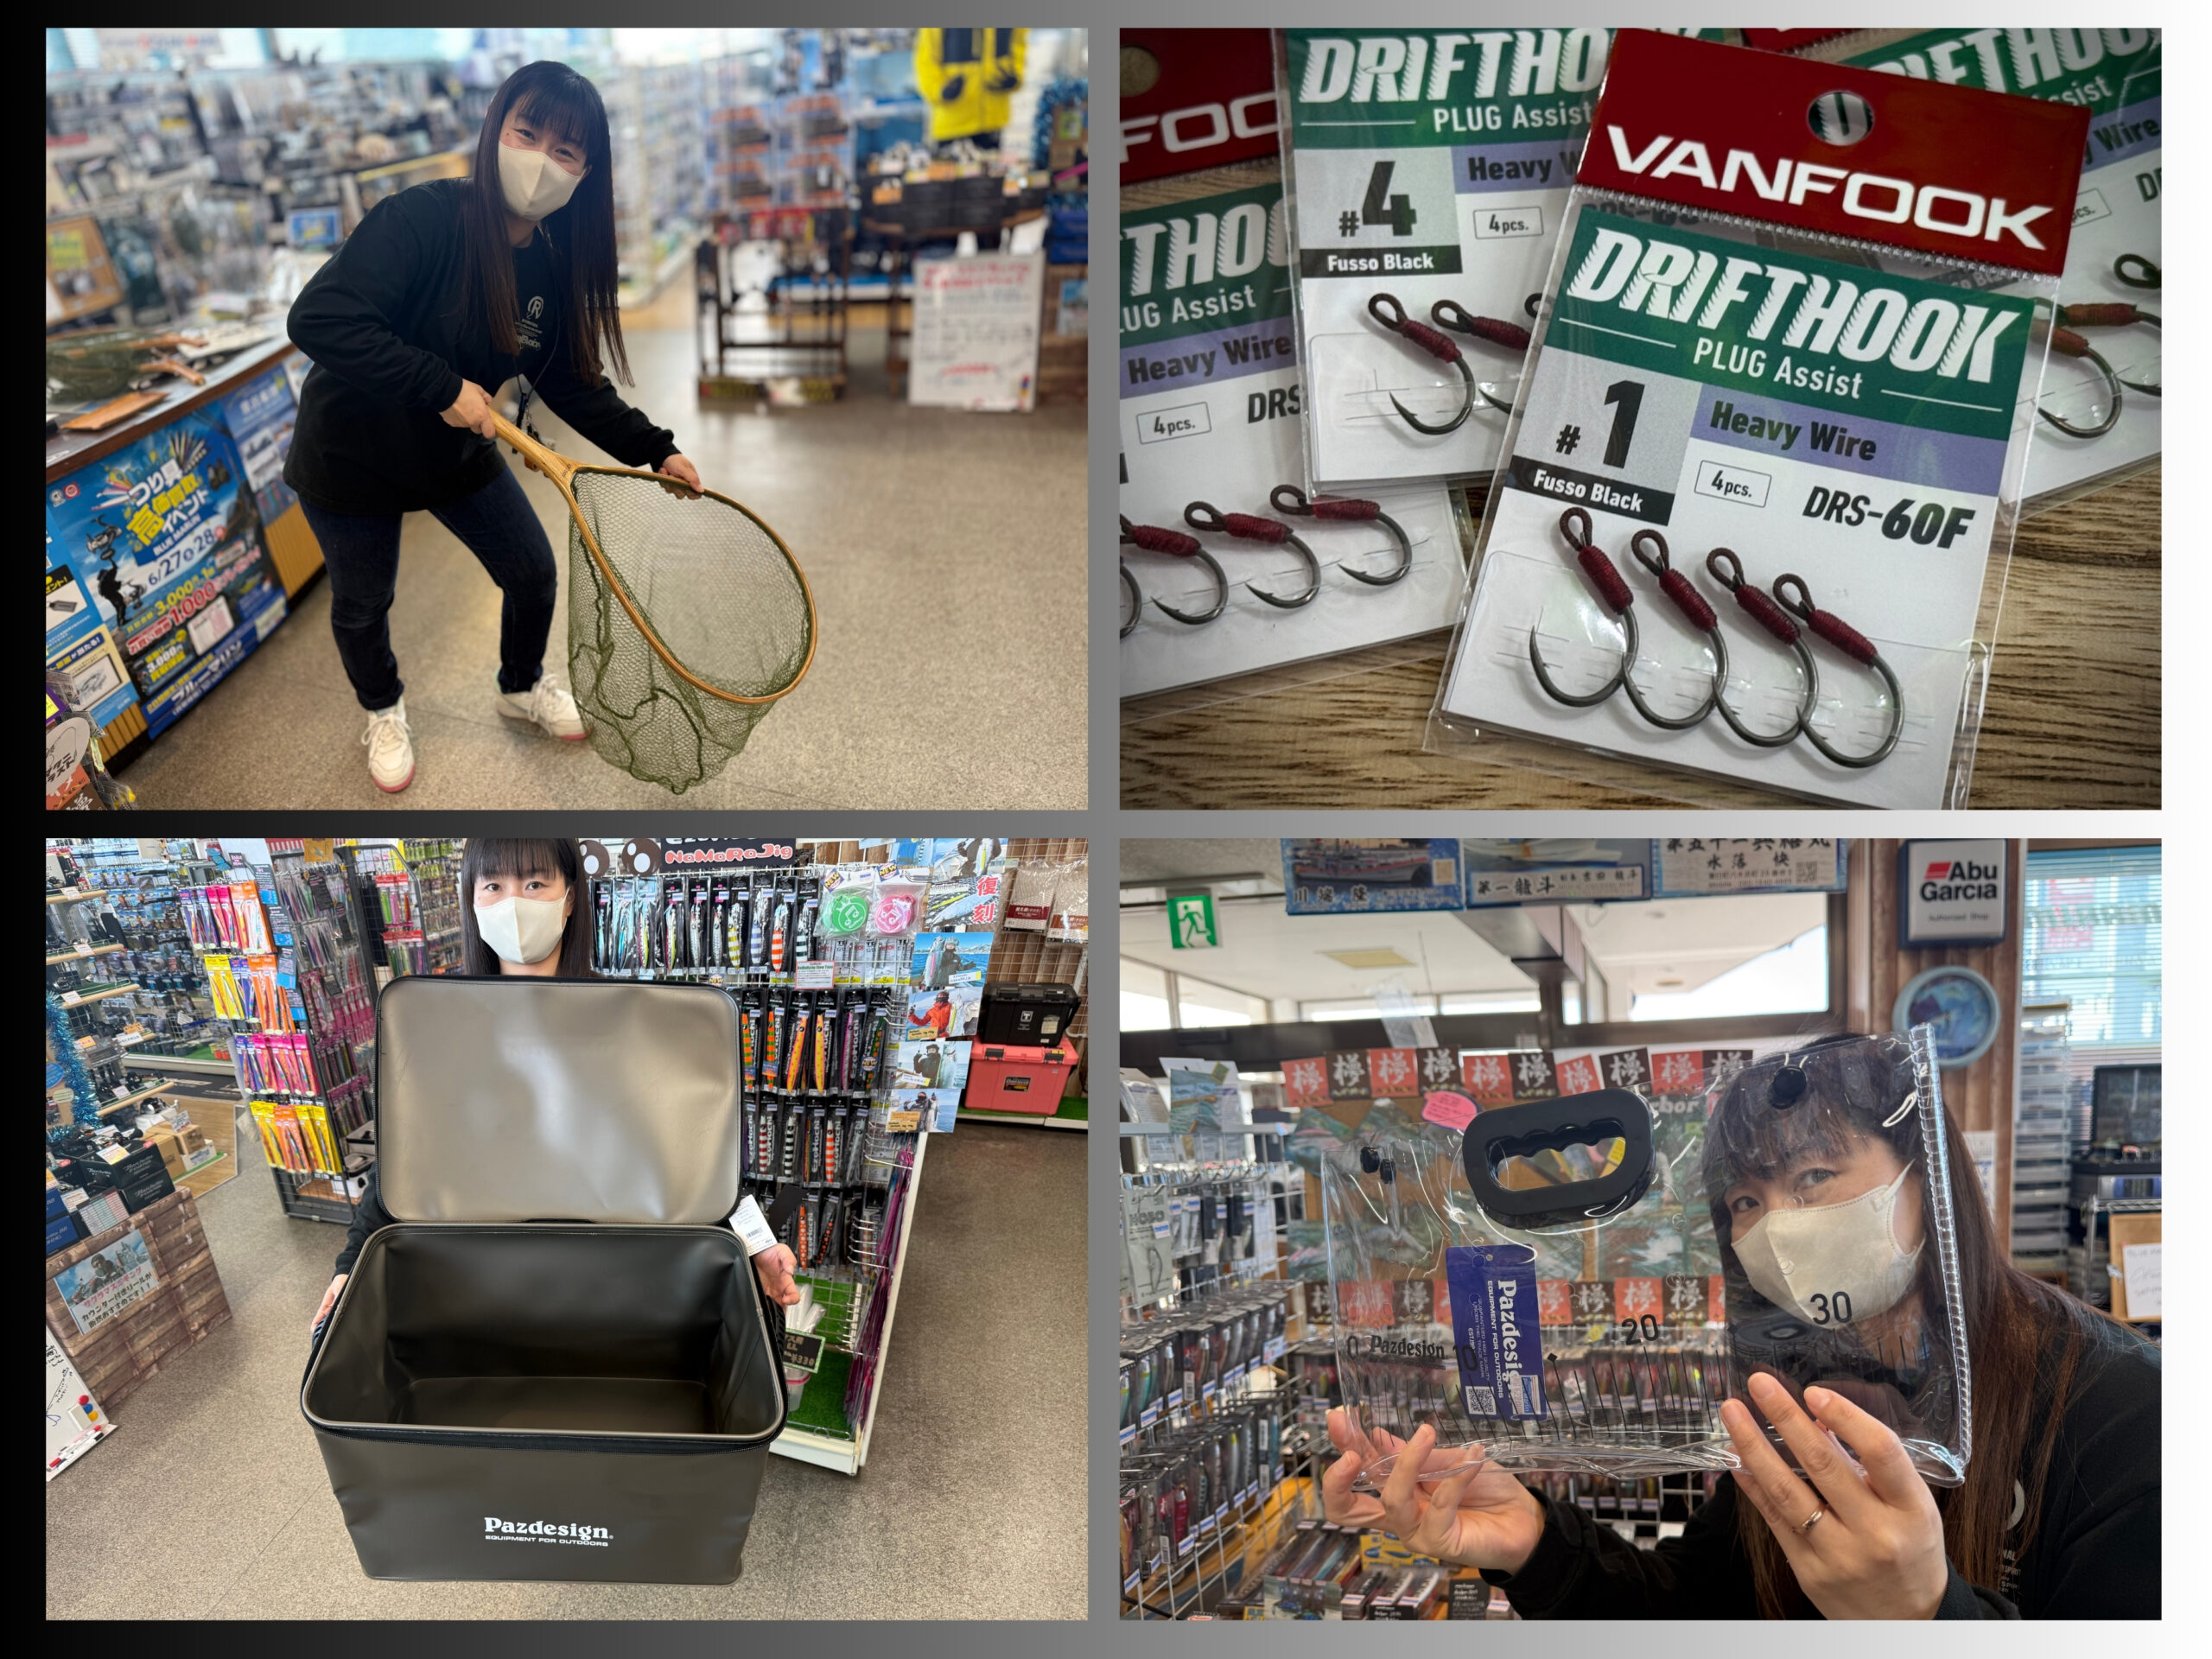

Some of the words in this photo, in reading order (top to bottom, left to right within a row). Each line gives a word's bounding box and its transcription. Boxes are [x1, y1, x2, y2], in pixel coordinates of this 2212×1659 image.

[1433, 105, 1503, 133] PLUG
[1511, 101, 1593, 131] Assist
[1469, 156, 1552, 184] Heavy
[1606, 124, 2055, 251] VANFOOK
[1326, 253, 1379, 273] Fusso
[1383, 251, 1434, 271] Black
[1171, 283, 1256, 324] Assist
[1566, 226, 2020, 384] DRIFTHOOK
[1127, 348, 1216, 385] Heavy
[1223, 335, 1293, 365] Wire
[1693, 337, 1766, 378] PLUG
[1774, 354, 1863, 399] Assist
[1710, 400, 1802, 451] Heavy
[1810, 420, 1877, 461] Wire
[1532, 467, 1586, 499] Fusso
[1590, 480, 1643, 512] Black
[162, 488, 209, 533] イベント
[1801, 485, 1976, 550] DRS-60F
[1948, 861, 1998, 881] Abu
[972, 876, 999, 924] 復刻
[1920, 881, 1998, 903] Garcia
[1810, 1291, 1853, 1325] 30
[1487, 1280, 1497, 1331] EQUIPMENT
[1494, 1351, 1504, 1399] OUTDOORS
[1621, 1313, 1660, 1346] 20
[1369, 1334, 1447, 1364] Pazdesign
[1452, 1344, 1478, 1372] 10
[484, 1516, 609, 1541] Pazdesign
[485, 1535, 537, 1543] EQUIPMENT
[558, 1538, 609, 1548] OUTDOORS
